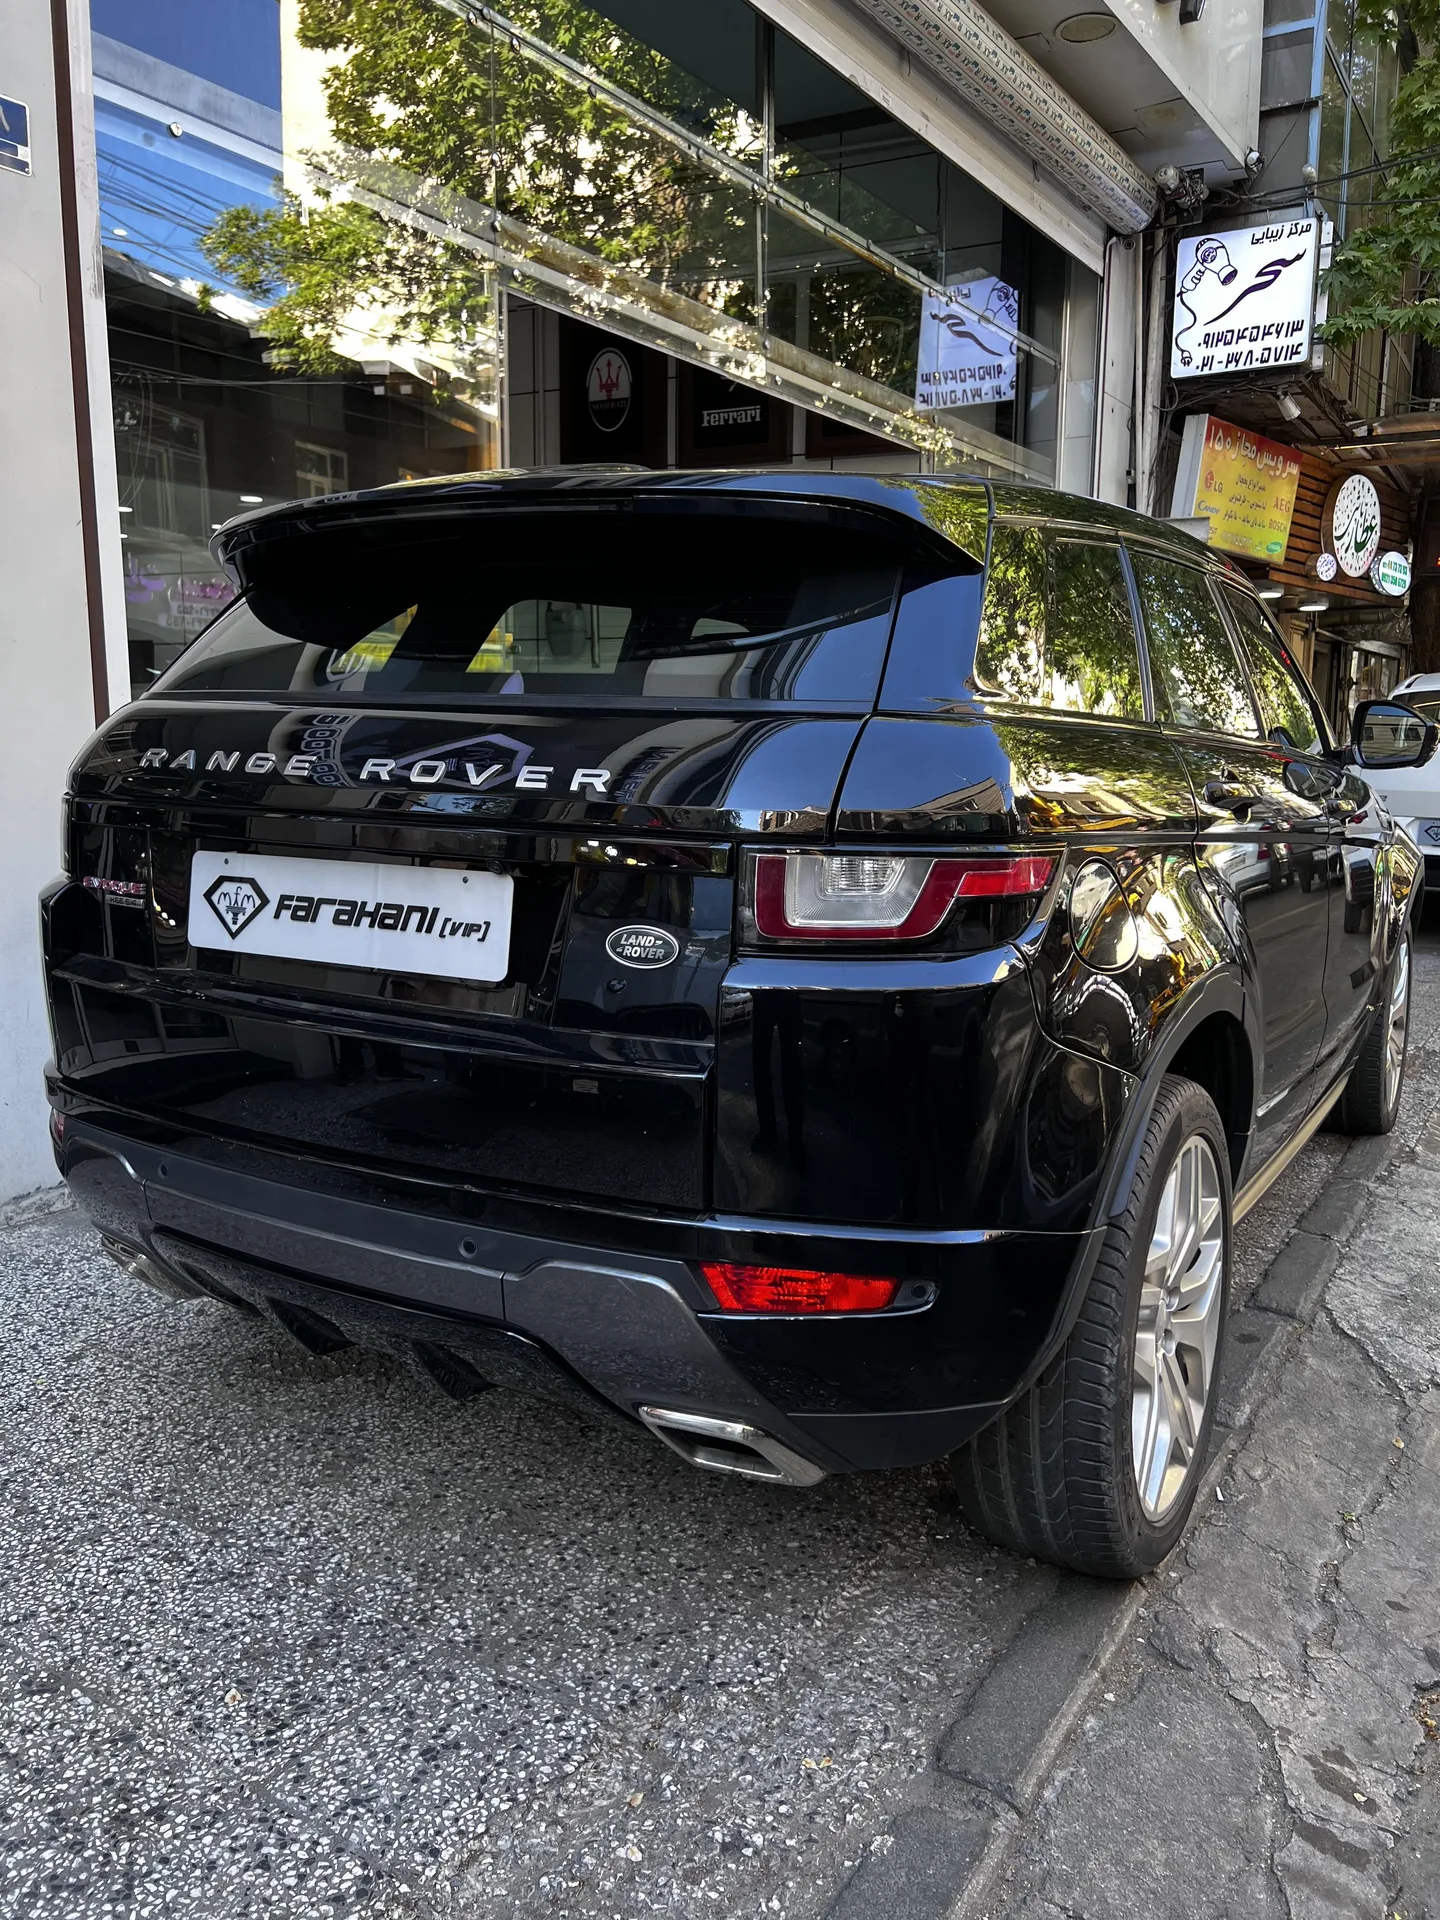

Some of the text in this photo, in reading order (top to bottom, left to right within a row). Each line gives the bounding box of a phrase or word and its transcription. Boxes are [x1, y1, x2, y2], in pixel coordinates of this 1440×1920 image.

[1251, 222, 1312, 245] مرکز زیبایی
[701, 406, 761, 426] Ferrari
[1231, 431, 1257, 467] مجاز
[1256, 451, 1298, 478] سرویس
[1213, 481, 1223, 493] LG
[1273, 496, 1291, 513] AEG
[1268, 518, 1288, 533] BOSCH
[138, 747, 318, 777] RANGE
[359, 757, 612, 794] ROVER
[83, 876, 147, 896] EVOQUE
[620, 933, 655, 947] LAND
[622, 945, 665, 960] ROVER
